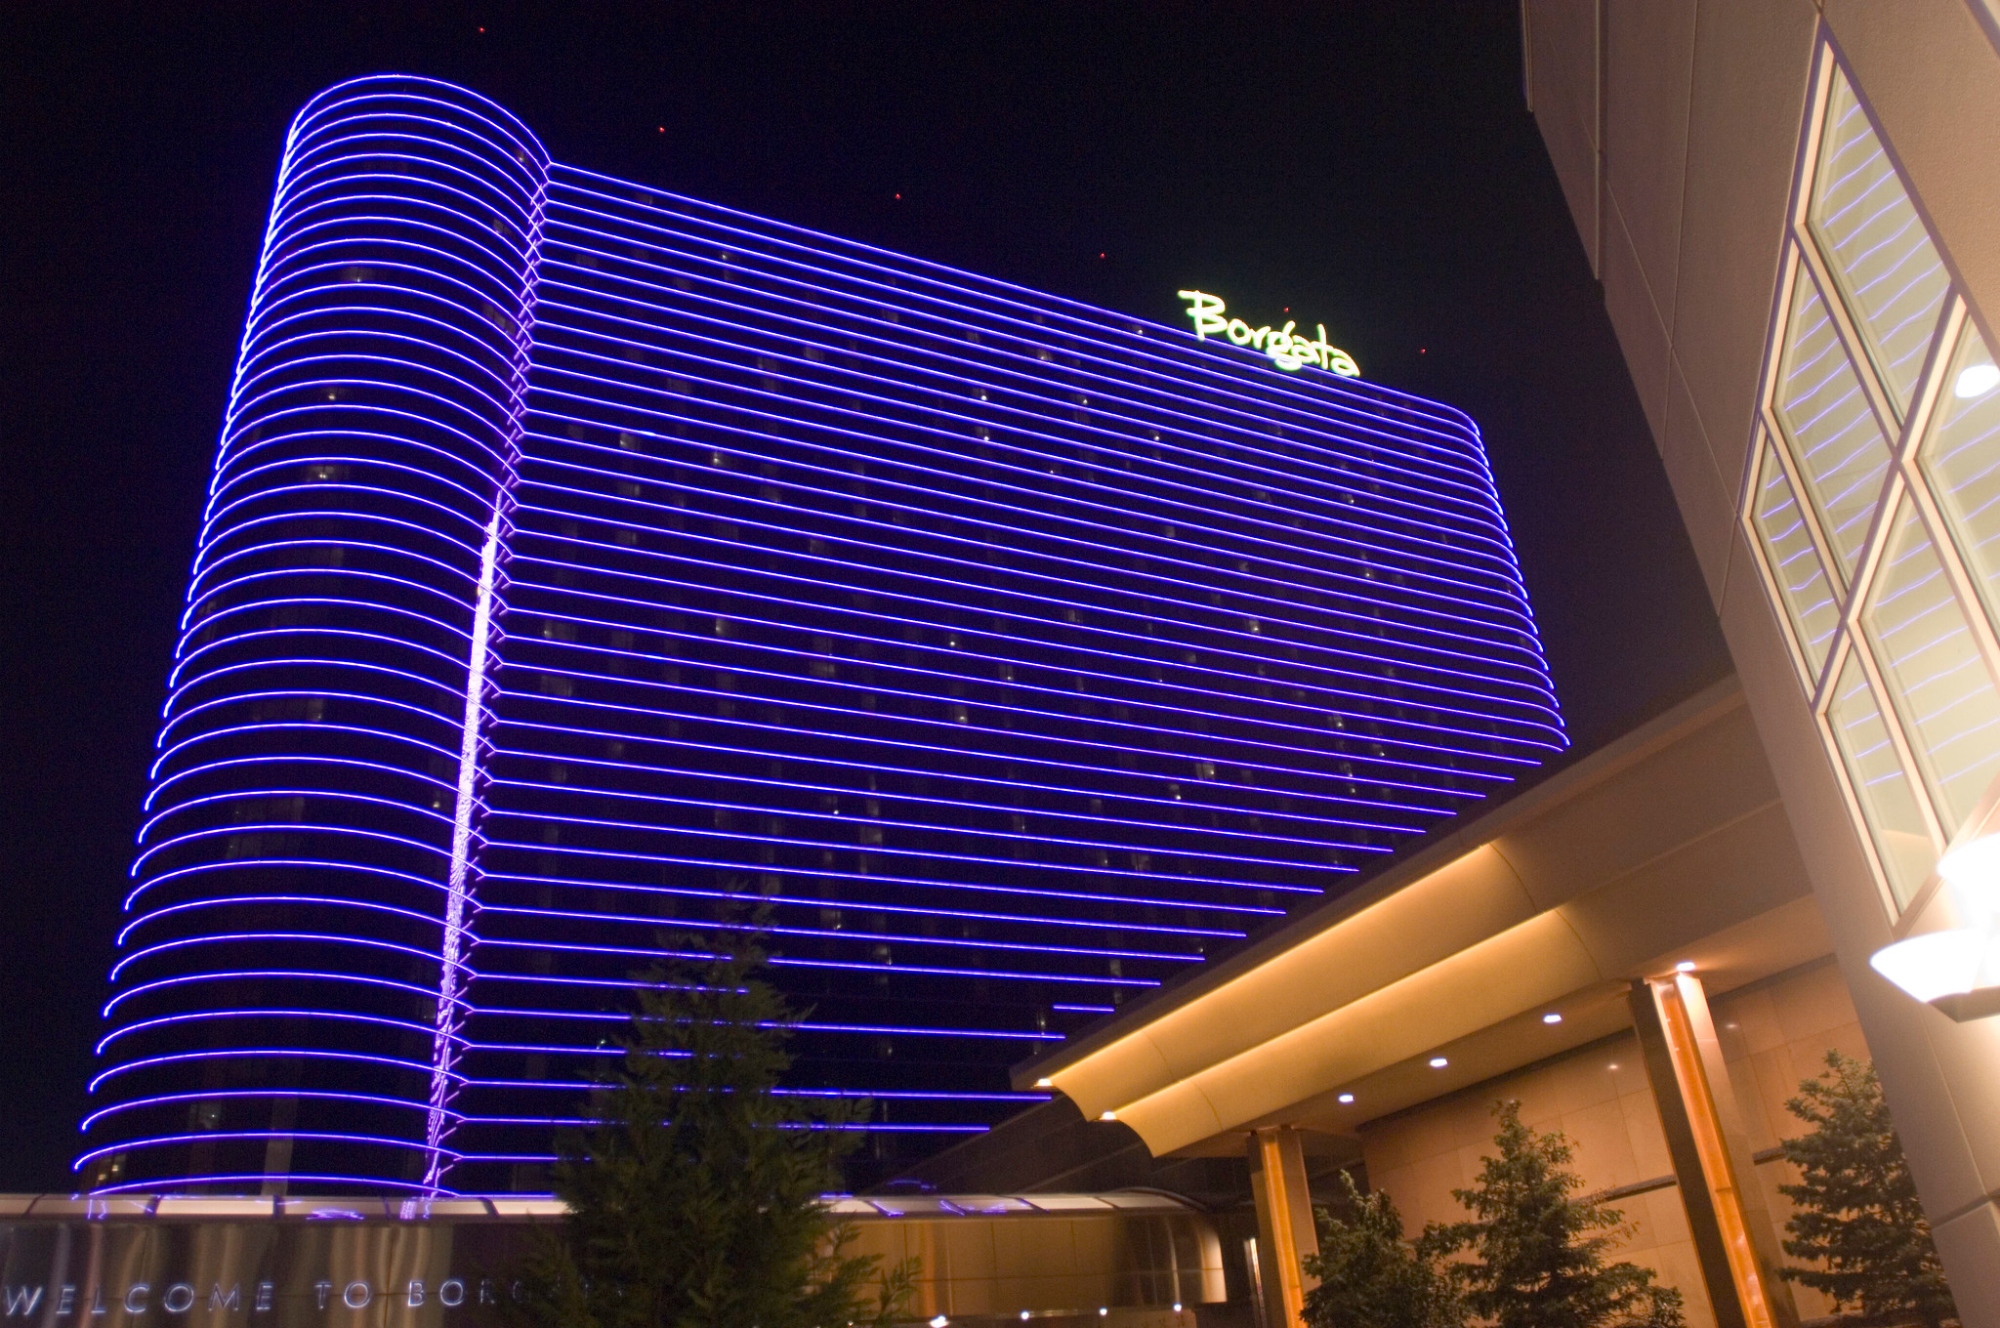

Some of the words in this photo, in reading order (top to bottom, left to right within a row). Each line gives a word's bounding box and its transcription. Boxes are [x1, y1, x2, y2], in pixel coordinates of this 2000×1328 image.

[1178, 290, 1360, 376] Borgata
[4, 1282, 274, 1316] WELCOME
[313, 1281, 371, 1310] TO
